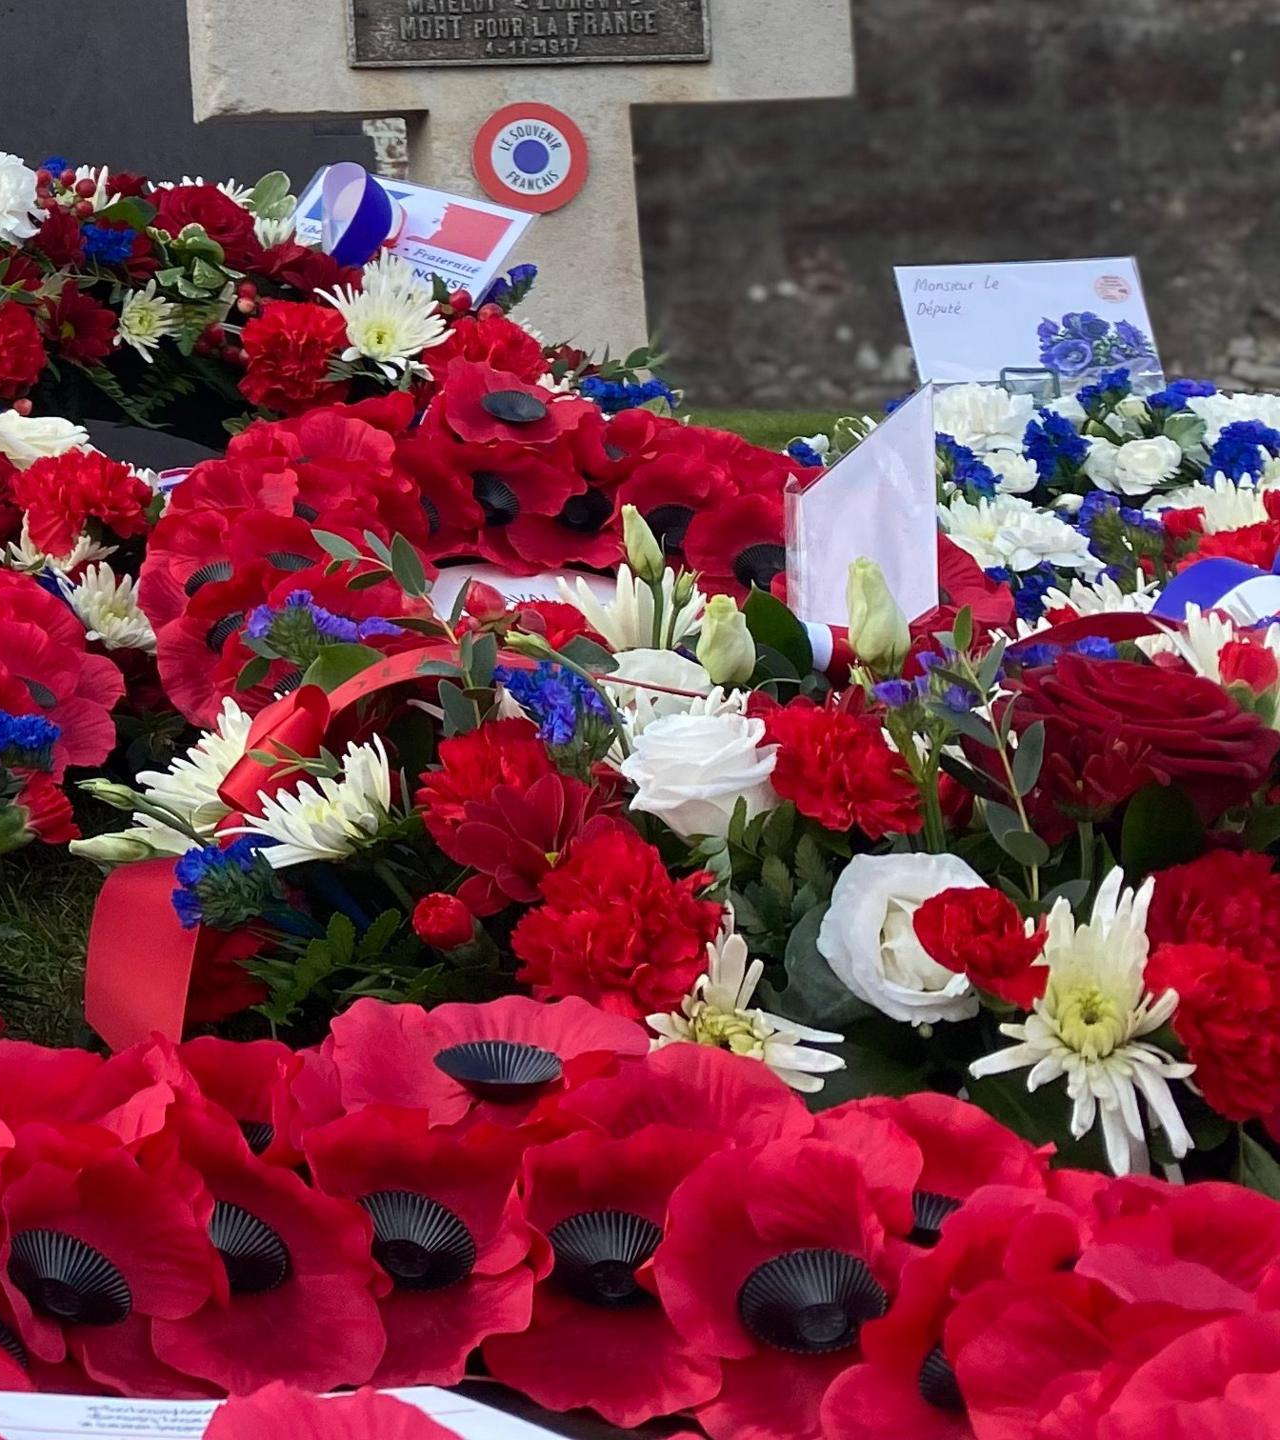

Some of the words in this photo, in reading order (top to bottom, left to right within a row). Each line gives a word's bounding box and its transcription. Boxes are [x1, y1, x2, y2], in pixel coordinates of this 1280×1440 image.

[399, 15, 464, 41] MORT
[473, 17, 524, 40] POUR
[532, 16, 559, 38] LA
[567, 10, 658, 36] FRANCE
[498, 137, 514, 152] LE
[509, 124, 563, 151] SOUVENIR
[504, 169, 561, 191] FRANÇAIS
[412, 247, 482, 276] Fraternité
[913, 277, 975, 294] Monsieur
[916, 300, 962, 318] Député
